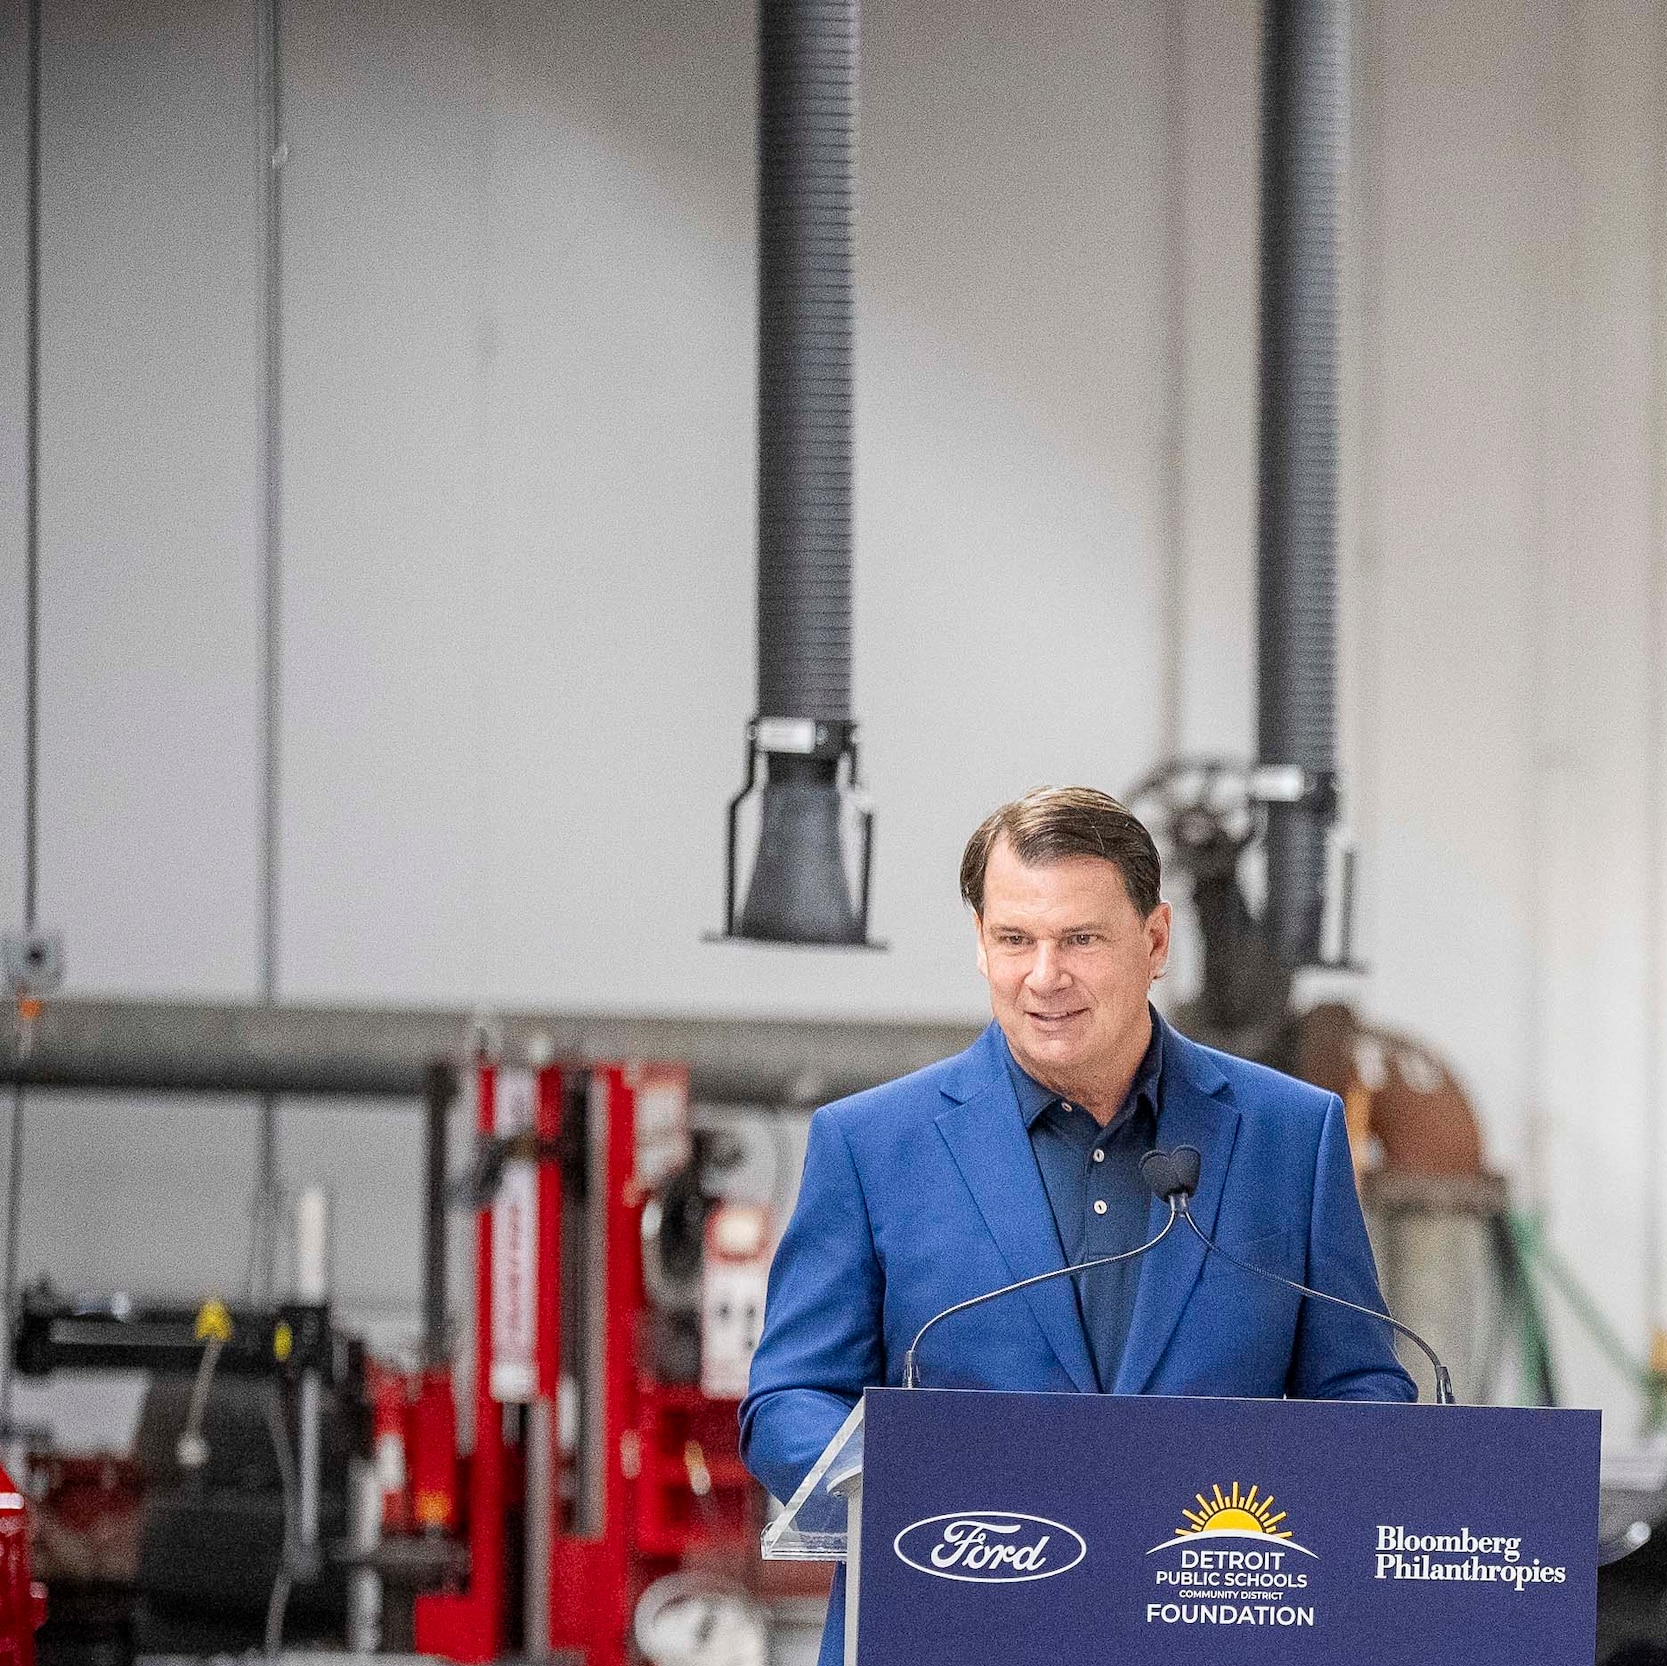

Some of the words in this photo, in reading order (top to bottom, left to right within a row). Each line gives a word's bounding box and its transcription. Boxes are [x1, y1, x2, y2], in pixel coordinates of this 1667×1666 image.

[930, 1519, 1051, 1574] Ford
[1375, 1525, 1522, 1559] Bloomberg
[1181, 1550, 1286, 1571] DETROIT
[1374, 1553, 1567, 1591] Philanthropies
[1156, 1570, 1221, 1587] PUBLIC
[1223, 1572, 1308, 1589] SCHOOLS
[1178, 1589, 1237, 1600] COMMUNITY
[1240, 1590, 1284, 1601] DISTRICT
[1146, 1603, 1314, 1627] FOUNDATION
